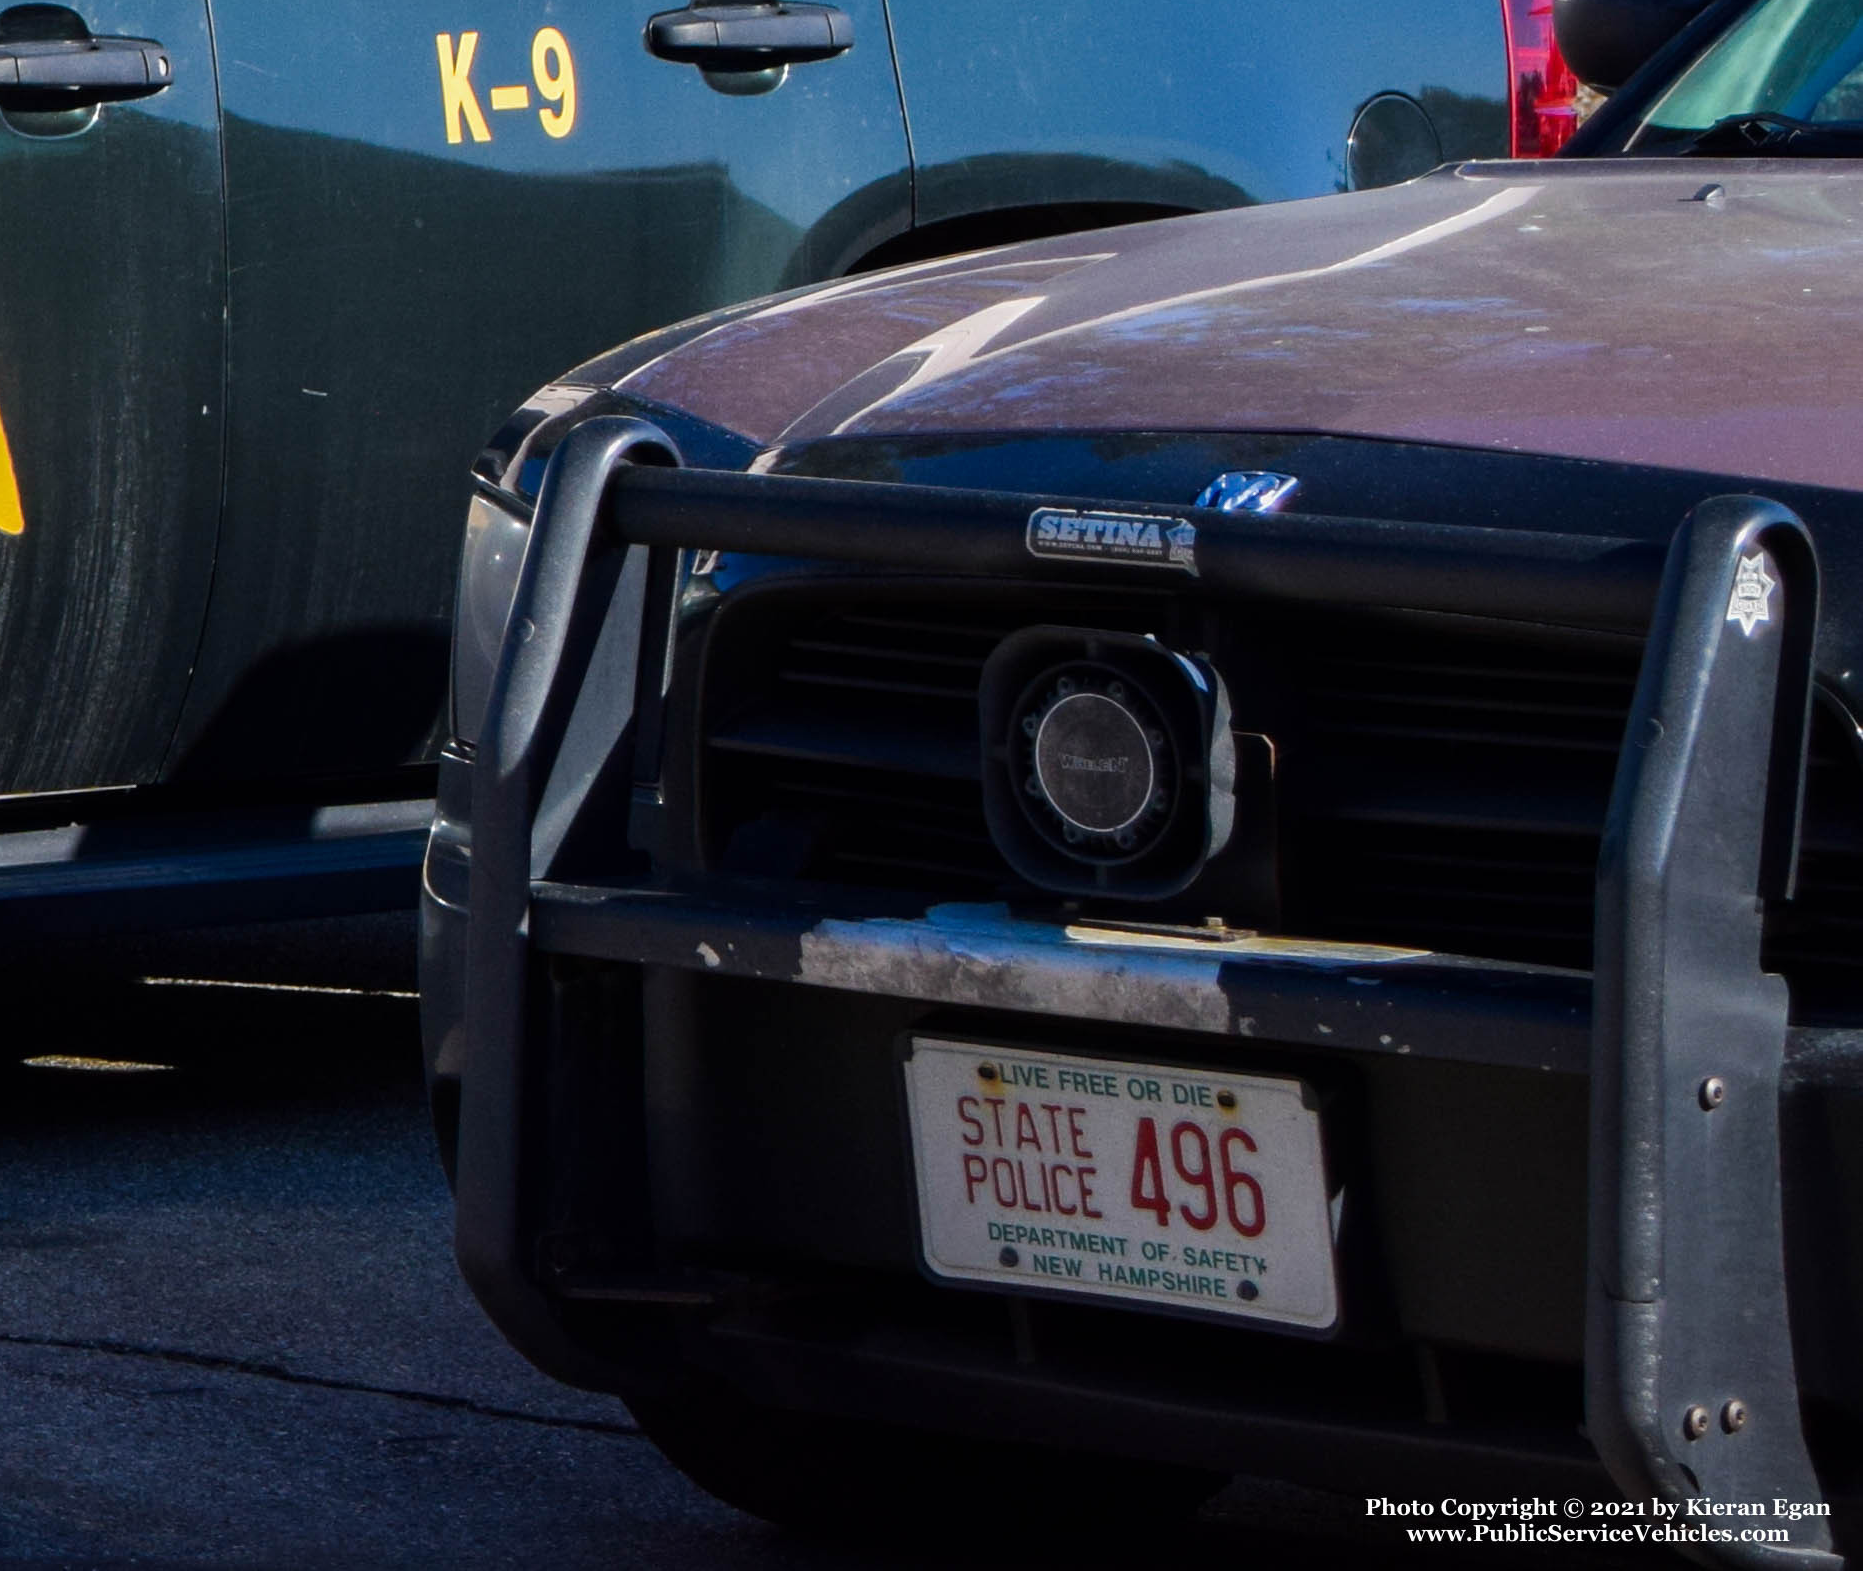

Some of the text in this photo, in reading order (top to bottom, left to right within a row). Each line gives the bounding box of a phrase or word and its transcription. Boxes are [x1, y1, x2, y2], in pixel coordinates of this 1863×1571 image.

[435, 27, 576, 144] K-9
[1037, 515, 1162, 548] SETINA
[999, 1062, 1214, 1107] LIVE FREE OR DIE
[957, 1096, 1093, 1159] STATE
[963, 1153, 1103, 1219] POLICE
[1130, 1116, 1266, 1238] 496
[987, 1221, 1267, 1275] DEPARTMENT OF SAFETY
[1032, 1254, 1228, 1298] NEW HAMPSHIRE
